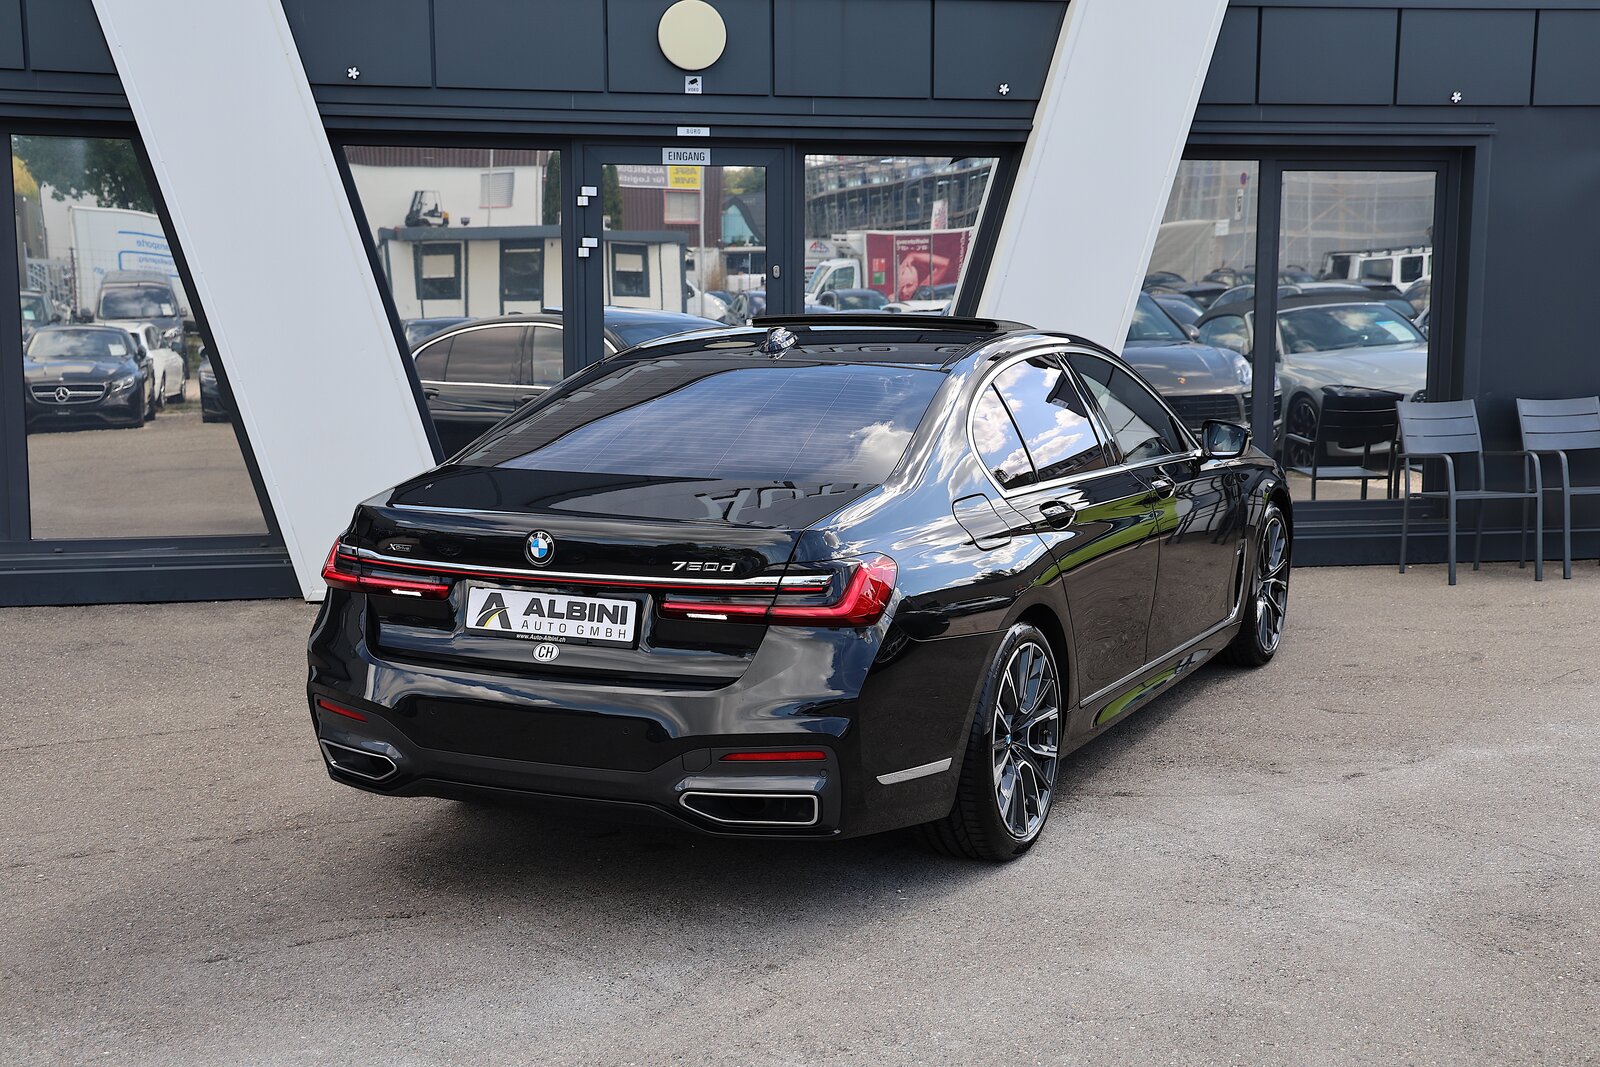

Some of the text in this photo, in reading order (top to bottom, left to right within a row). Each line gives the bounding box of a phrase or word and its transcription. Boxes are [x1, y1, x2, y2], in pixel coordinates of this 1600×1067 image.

[668, 151, 705, 161] EINGANG
[529, 532, 552, 544] BMW
[671, 561, 737, 572] 750d
[522, 597, 629, 626] ALBINI
[521, 619, 626, 639] AUTO GMBH
[538, 645, 554, 658] CH
